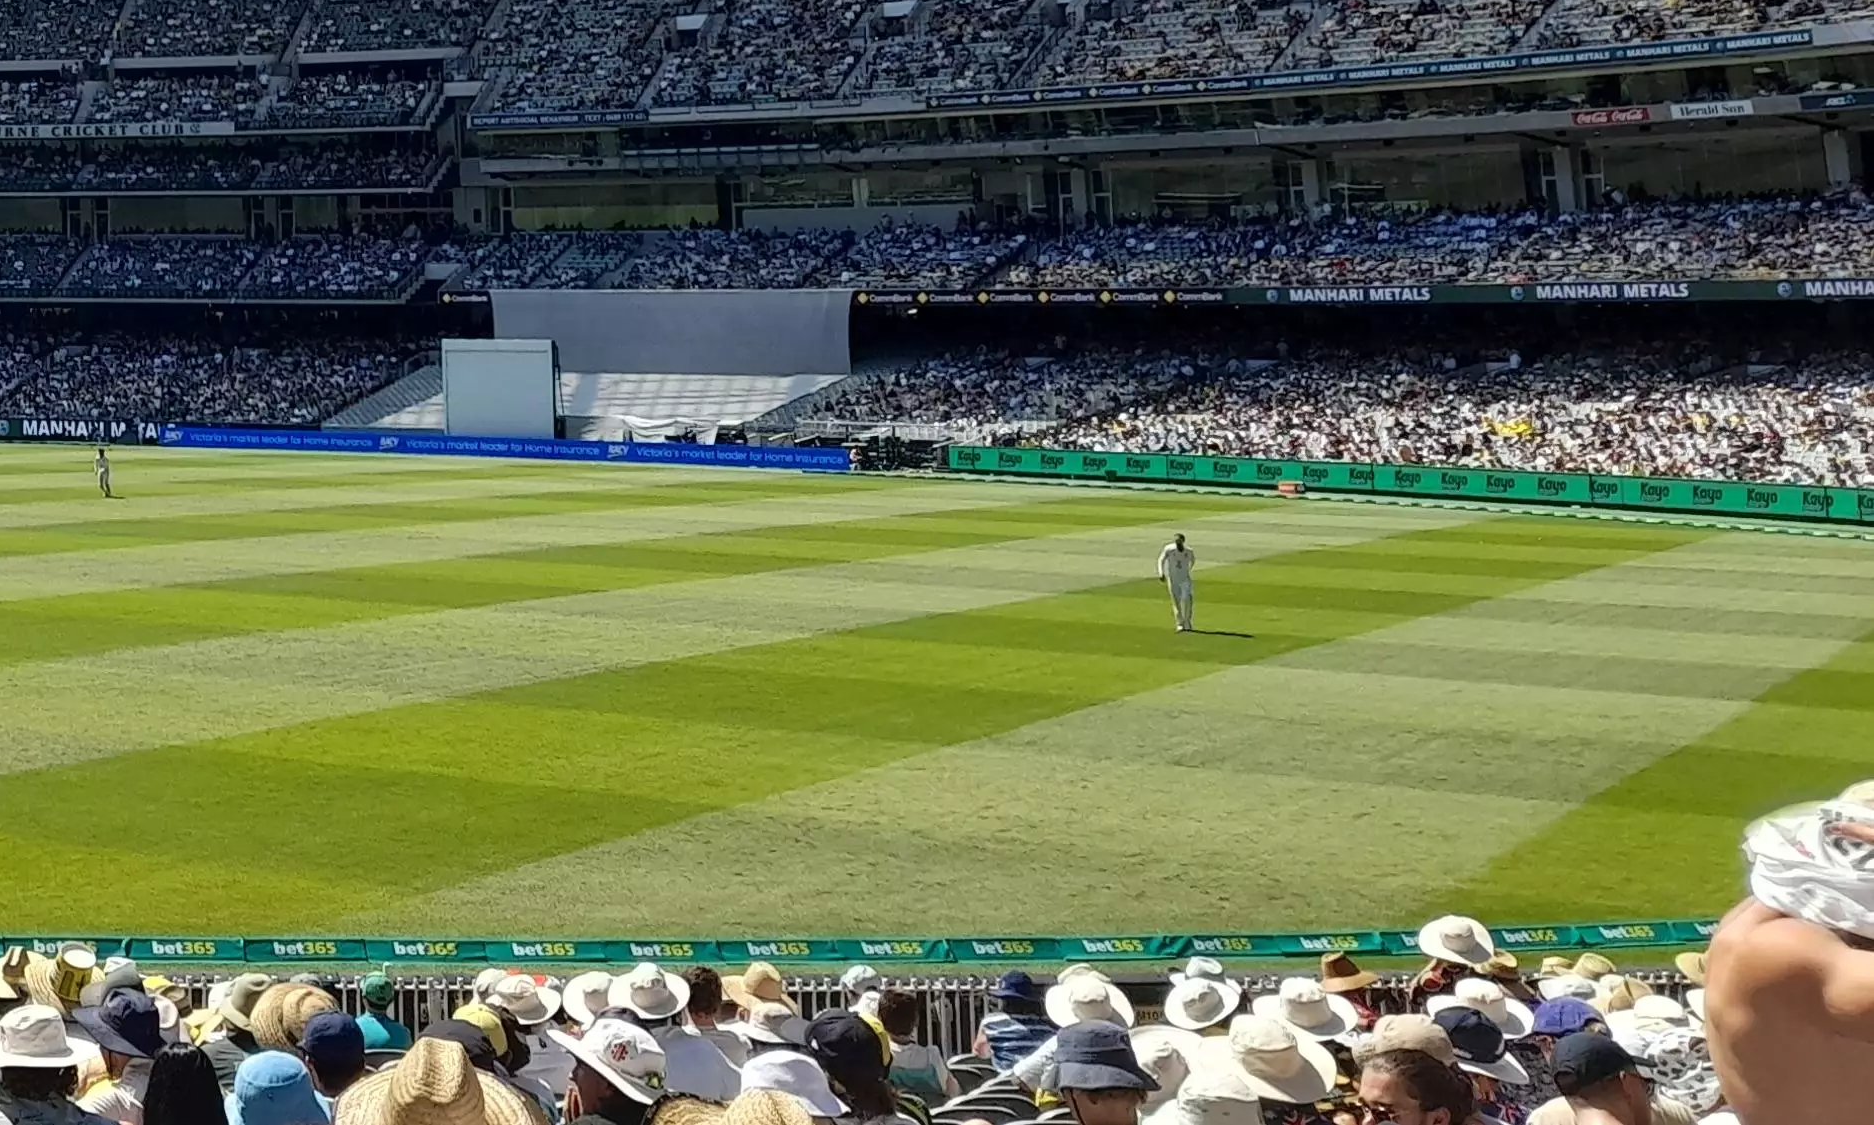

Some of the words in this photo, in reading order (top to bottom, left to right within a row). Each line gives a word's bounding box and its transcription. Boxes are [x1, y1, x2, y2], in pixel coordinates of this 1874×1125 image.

[1680, 104, 1718, 117] Herald
[1721, 102, 1745, 115] Sun
[51, 125, 127, 137] CRICKET
[139, 124, 184, 136] CLUB
[869, 292, 913, 302] CommBank
[929, 292, 974, 303] CommBank
[990, 292, 1034, 303] CommBank
[1050, 291, 1095, 302] CommBank
[1112, 291, 1159, 302] CommBank
[1176, 291, 1222, 301] CommBank
[1289, 288, 1364, 302] MANHARI
[1369, 287, 1431, 302] METALS
[1536, 284, 1617, 300] MANHARI
[1623, 283, 1689, 298] METALS
[262, 434, 288, 444] leader
[290, 435, 301, 445] for
[304, 436, 328, 446] Home
[330, 437, 373, 447] Insurance
[447, 440, 478, 450] market
[479, 441, 508, 451] leader
[510, 444, 523, 452] for
[524, 444, 552, 454] Home
[553, 445, 600, 456] Insurance
[636, 447, 678, 458] Victoria's
[681, 449, 714, 459] market
[717, 450, 747, 461] leader
[749, 451, 762, 461] for
[764, 452, 793, 463] Home
[795, 453, 844, 465] Insurance
[957, 451, 980, 465] Kayo
[999, 452, 1022, 467] Kayo
[1040, 453, 1064, 469] Kayo
[1083, 455, 1107, 471] Kayo
[1126, 457, 1150, 472] Kayo
[1169, 459, 1194, 473] Kayo
[1213, 461, 1237, 476] Kayo
[1256, 463, 1282, 478] Kayo
[1302, 464, 1328, 481] Kayo
[1349, 467, 1374, 484] Kayo
[1394, 469, 1421, 486] Kayo
[1441, 472, 1468, 488] Kayo
[1486, 474, 1515, 492] Kayo
[1538, 477, 1567, 494] Kayo
[1589, 478, 1617, 497] Kayo
[1640, 482, 1669, 499] Kayo
[1693, 485, 1722, 502] Kayo
[1747, 487, 1777, 505] Kayo
[1803, 490, 1834, 509] Kayo
[1501, 928, 1557, 945] bet365
[1599, 923, 1655, 939] bet365
[152, 940, 215, 955] bet365
[273, 941, 336, 956] bet365
[393, 941, 457, 957] bet365
[512, 941, 575, 957] bet365
[630, 941, 693, 957] bet365
[746, 941, 809, 957] bet365
[862, 940, 923, 956] bet365
[972, 940, 1033, 955] bet365
[1082, 937, 1143, 953] bet365
[1193, 936, 1252, 952] bet365
[1300, 934, 1359, 950] bet365
